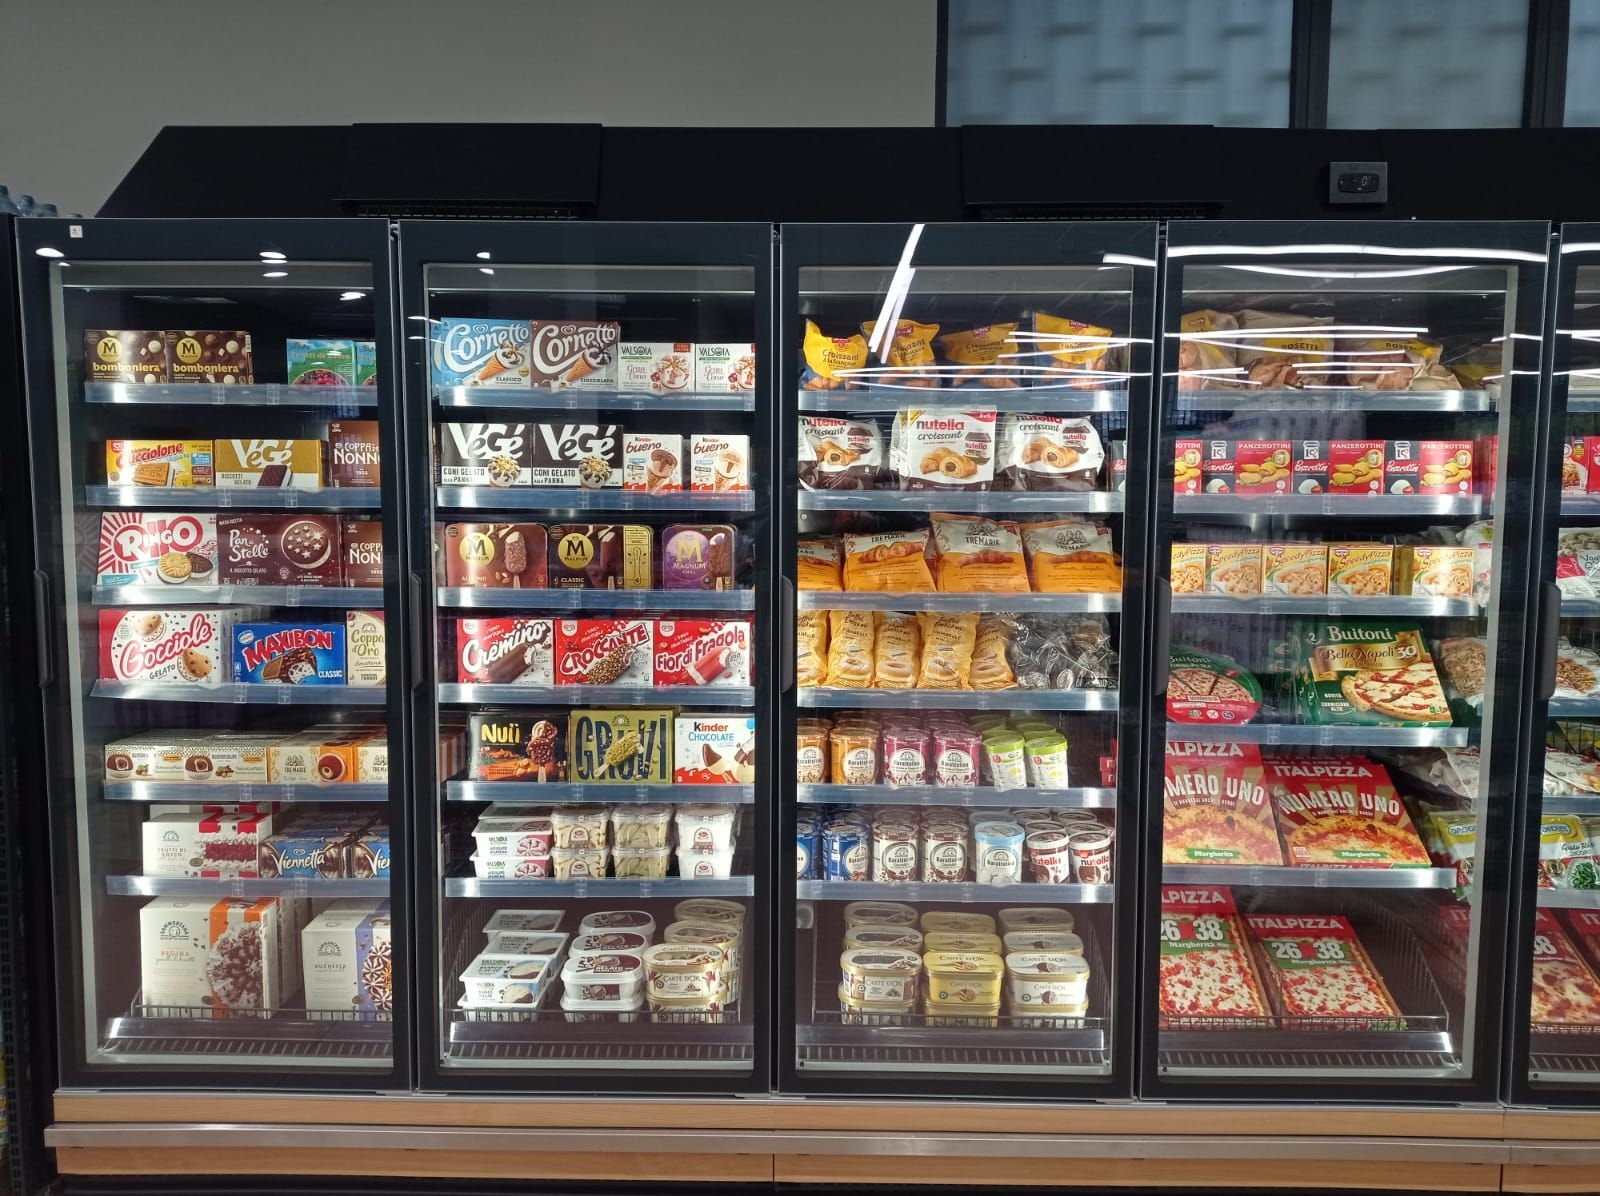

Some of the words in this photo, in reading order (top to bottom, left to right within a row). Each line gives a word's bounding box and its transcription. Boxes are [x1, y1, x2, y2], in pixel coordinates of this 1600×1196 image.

[444, 323, 529, 373] Cornetto
[532, 324, 616, 374] Cornetto
[621, 345, 652, 356] VALSOIA
[698, 346, 730, 357] VALSOIA
[822, 349, 859, 360] Croissant
[92, 362, 161, 372] bomboniera
[173, 363, 239, 373] bomboniera
[801, 417, 849, 427] nutella
[916, 418, 965, 430] nutella
[805, 427, 845, 437] croissant
[918, 431, 963, 441] croissant
[344, 442, 371, 453] COPPA
[626, 442, 662, 454] bueno
[694, 442, 729, 454] bueno
[334, 449, 380, 465] NONN
[443, 468, 459, 476] CONI
[552, 469, 576, 477] GELATO
[229, 529, 248, 548] Pan
[229, 543, 269, 562] Stelle
[359, 542, 383, 552] COPP
[1369, 551, 1390, 560] Pizza
[673, 562, 706, 570] MAGNUM
[351, 630, 384, 647] Coppa
[1328, 625, 1393, 642] Buitoni
[120, 612, 213, 678] Gocciole
[242, 628, 333, 672] MAXIBON
[462, 621, 550, 673] Cremino
[561, 624, 648, 674] CROCCANTE
[656, 654, 682, 671] Fior
[694, 626, 745, 662] Fragola
[1320, 648, 1354, 662] Bella
[1354, 646, 1394, 662] Napoli
[148, 664, 176, 680] GELATO
[318, 670, 342, 678] CLASSIC
[481, 722, 520, 744] Nuii
[688, 732, 735, 742] CHOCOLATE
[1273, 766, 1374, 778] ITALPIZZA
[1226, 777, 1265, 806] UNO
[1278, 790, 1356, 815] NUMERO
[1360, 792, 1400, 816] UNO
[1194, 850, 1234, 858] Margherita
[270, 849, 326, 875] Viennetta
[1248, 918, 1345, 930] ITALPIZZA
[1192, 920, 1224, 941] 38
[1272, 942, 1302, 960] 26
[1313, 942, 1345, 960] 38
